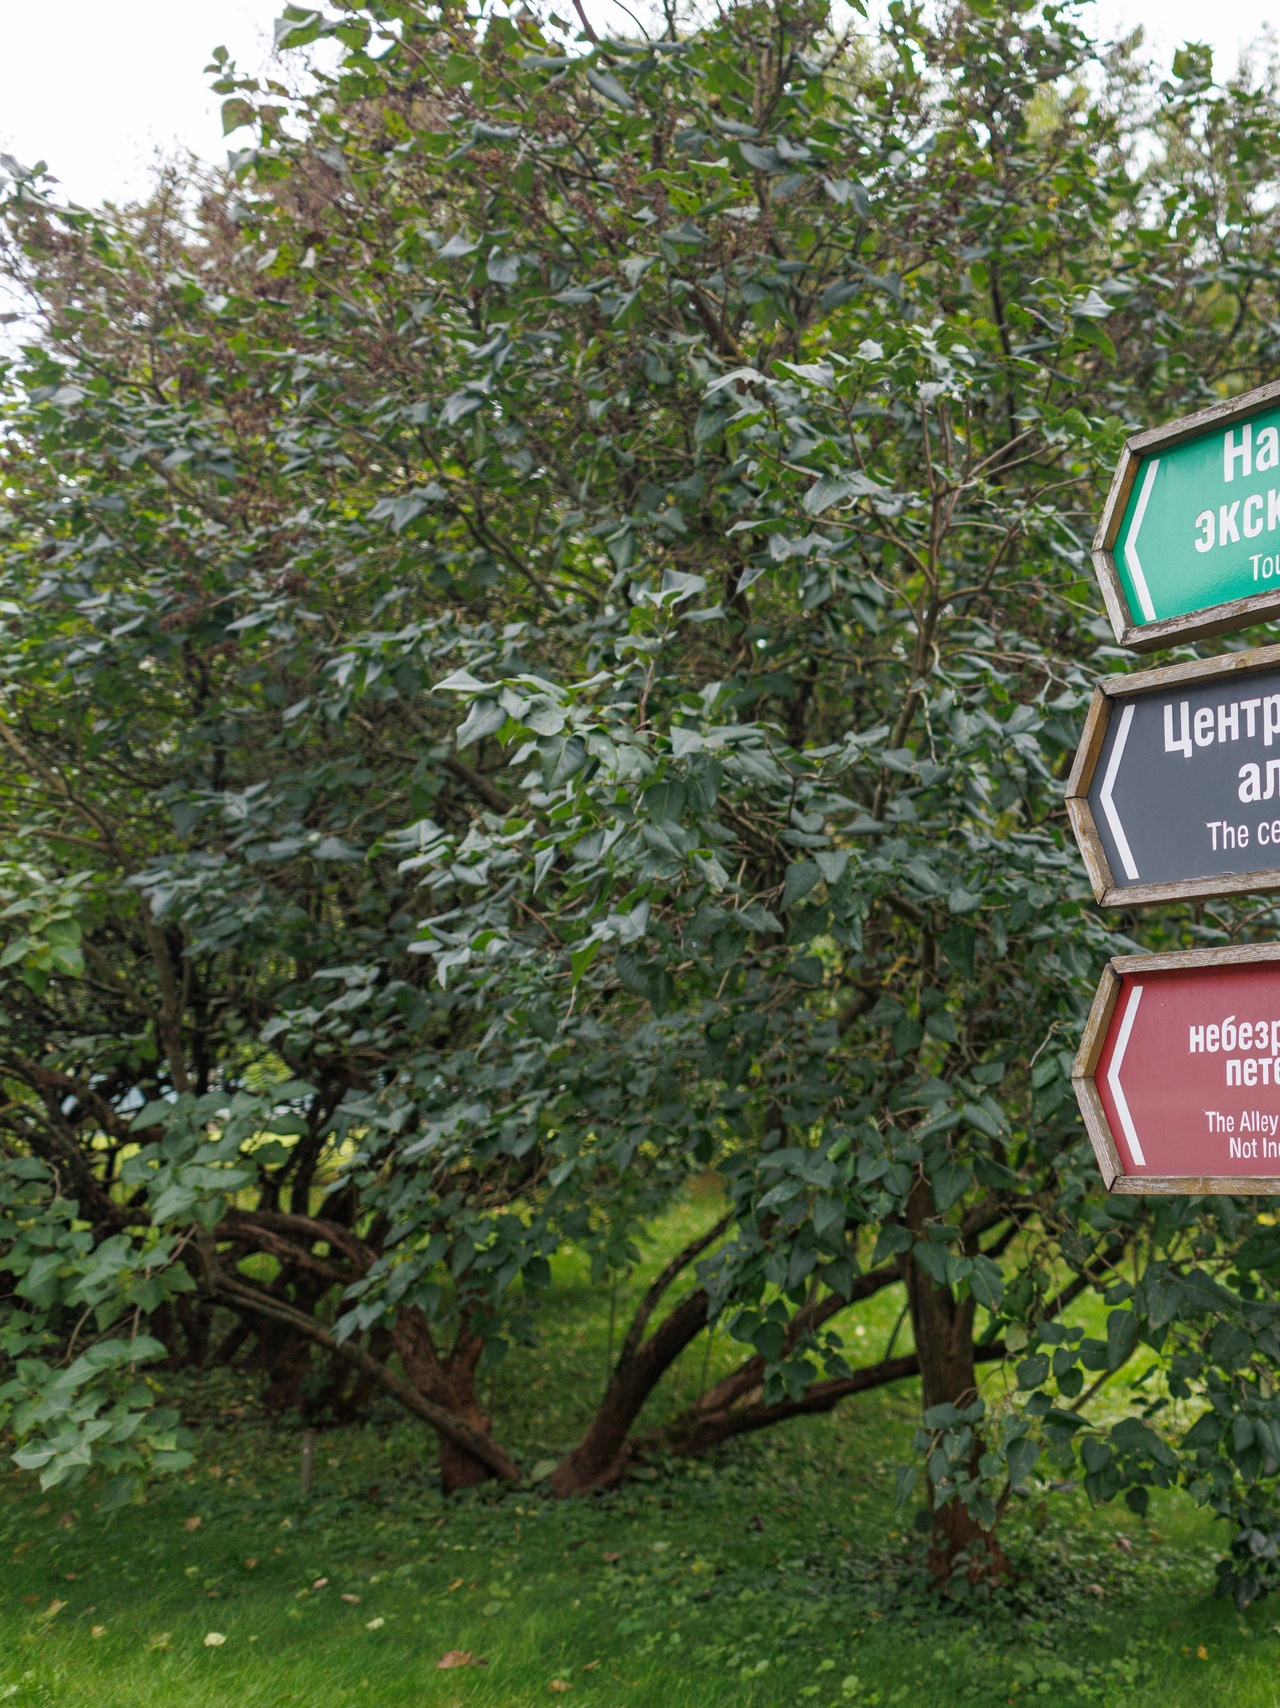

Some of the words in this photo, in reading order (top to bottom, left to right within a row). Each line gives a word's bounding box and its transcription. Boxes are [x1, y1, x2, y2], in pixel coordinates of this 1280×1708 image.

[1207, 821, 1249, 851] The
[1206, 1111, 1235, 1133] The
[1240, 1110, 1279, 1136] Alley
[1229, 1137, 1258, 1158] Not
